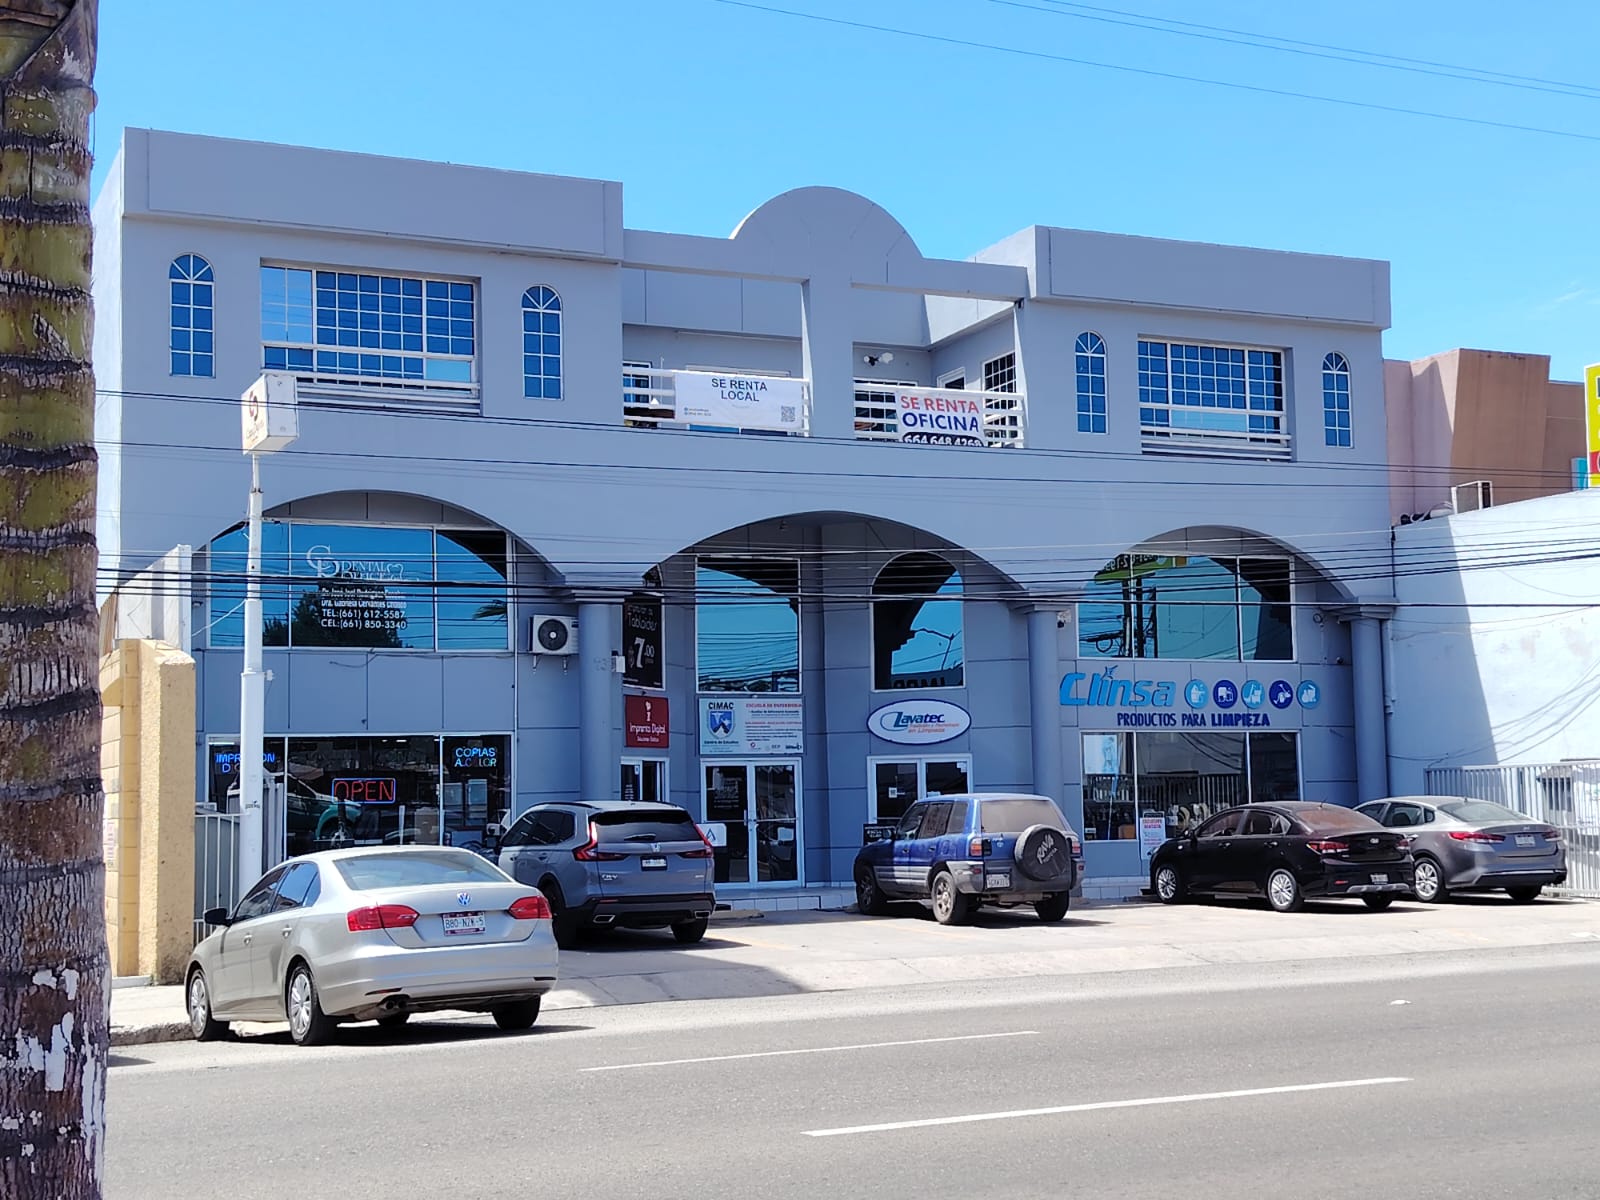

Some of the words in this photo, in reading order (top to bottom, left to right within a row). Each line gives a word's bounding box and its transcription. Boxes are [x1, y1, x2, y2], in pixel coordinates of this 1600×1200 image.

[711, 378, 727, 389] SE
[730, 379, 768, 391] RENTA
[721, 390, 760, 402] LOCAL
[900, 395, 921, 410] SE
[923, 398, 980, 414] RENTA
[902, 412, 979, 432] OFICINA
[363, 610, 405, 619] 612-5587
[364, 620, 407, 629] 850-3340
[1059, 666, 1177, 707] Clinsa
[708, 702, 734, 710] CIMAC
[892, 711, 945, 728] Lavatec
[1117, 712, 1177, 727] PRODUCTOS
[1181, 712, 1206, 727] PARA
[1211, 713, 1270, 727] LIMPIEZA
[455, 747, 496, 758] COPIAS
[464, 757, 497, 767] CLOR
[334, 780, 394, 801] OPEN
